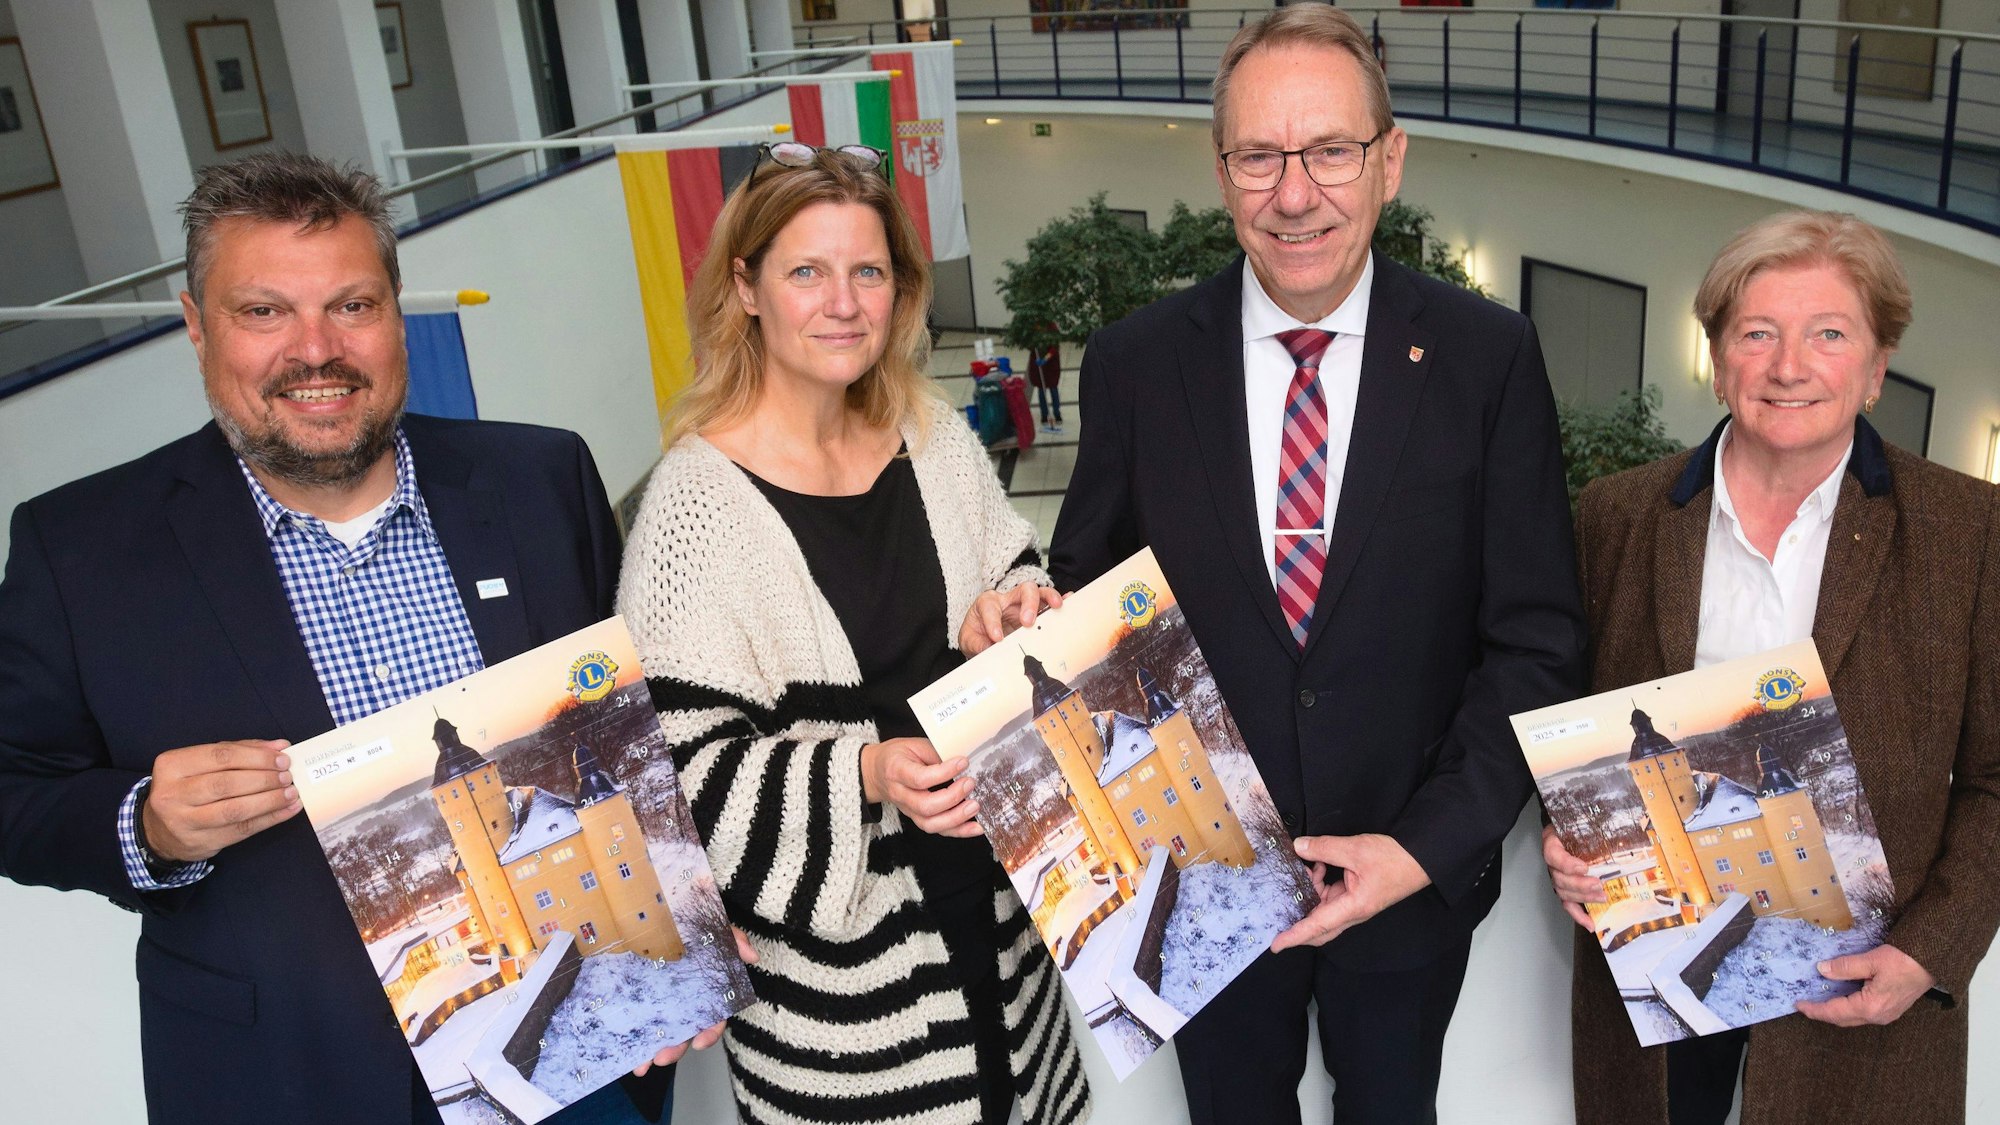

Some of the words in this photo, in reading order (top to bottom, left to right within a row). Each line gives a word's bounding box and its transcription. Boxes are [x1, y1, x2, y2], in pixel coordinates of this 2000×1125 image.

[1119, 582, 1141, 599] LIONS
[1130, 595, 1145, 613] L
[1160, 617, 1171, 631] 24
[571, 652, 602, 669] LIONS
[583, 666, 602, 686] L
[1183, 664, 1193, 677] 19
[1759, 669, 1789, 682] LIONS
[1771, 680, 1788, 697] L
[616, 694, 630, 707] 24
[937, 703, 957, 722] 2025
[1801, 706, 1816, 718] 24
[1096, 725, 1107, 736] 16
[1218, 731, 1224, 741] 9
[1533, 731, 1555, 742] 2025
[636, 746, 648, 759] 19
[1819, 751, 1831, 763] 19
[312, 761, 340, 779] 2025
[1179, 759, 1189, 772] 12
[1125, 772, 1131, 783] 3
[1010, 782, 1022, 796] 14
[1694, 782, 1707, 792] 16
[1647, 790, 1654, 800] 5
[508, 801, 522, 812] 16
[1588, 804, 1601, 815] 14
[666, 817, 673, 828] 9
[1152, 814, 1158, 824] 1
[1845, 814, 1852, 824] 9
[456, 820, 464, 831] 5
[1716, 826, 1723, 836] 3
[1785, 830, 1798, 841] 12
[1266, 837, 1277, 850] 23
[607, 844, 620, 856] 12
[1180, 848, 1187, 857] 4
[385, 851, 401, 864] 14
[534, 852, 541, 862] 3
[1233, 863, 1243, 877] 15
[1738, 866, 1743, 876] 1
[560, 898, 566, 908] 1
[1293, 891, 1304, 904] 10
[1762, 900, 1769, 909] 4
[1192, 908, 1203, 922] 22
[1870, 908, 1883, 920] 23
[1823, 926, 1835, 937] 15
[588, 935, 596, 944] 4
[701, 932, 714, 946] 23
[1248, 935, 1254, 944] 6
[653, 956, 665, 969] 15
[1159, 952, 1167, 963] 8
[1712, 971, 1719, 981] 8
[1193, 979, 1203, 993] 17
[1822, 982, 1829, 991] 6
[723, 990, 735, 1003] 10
[590, 998, 604, 1012] 22
[657, 1028, 664, 1038] 6
[539, 1039, 547, 1049] 8
[576, 1069, 588, 1082] 17
